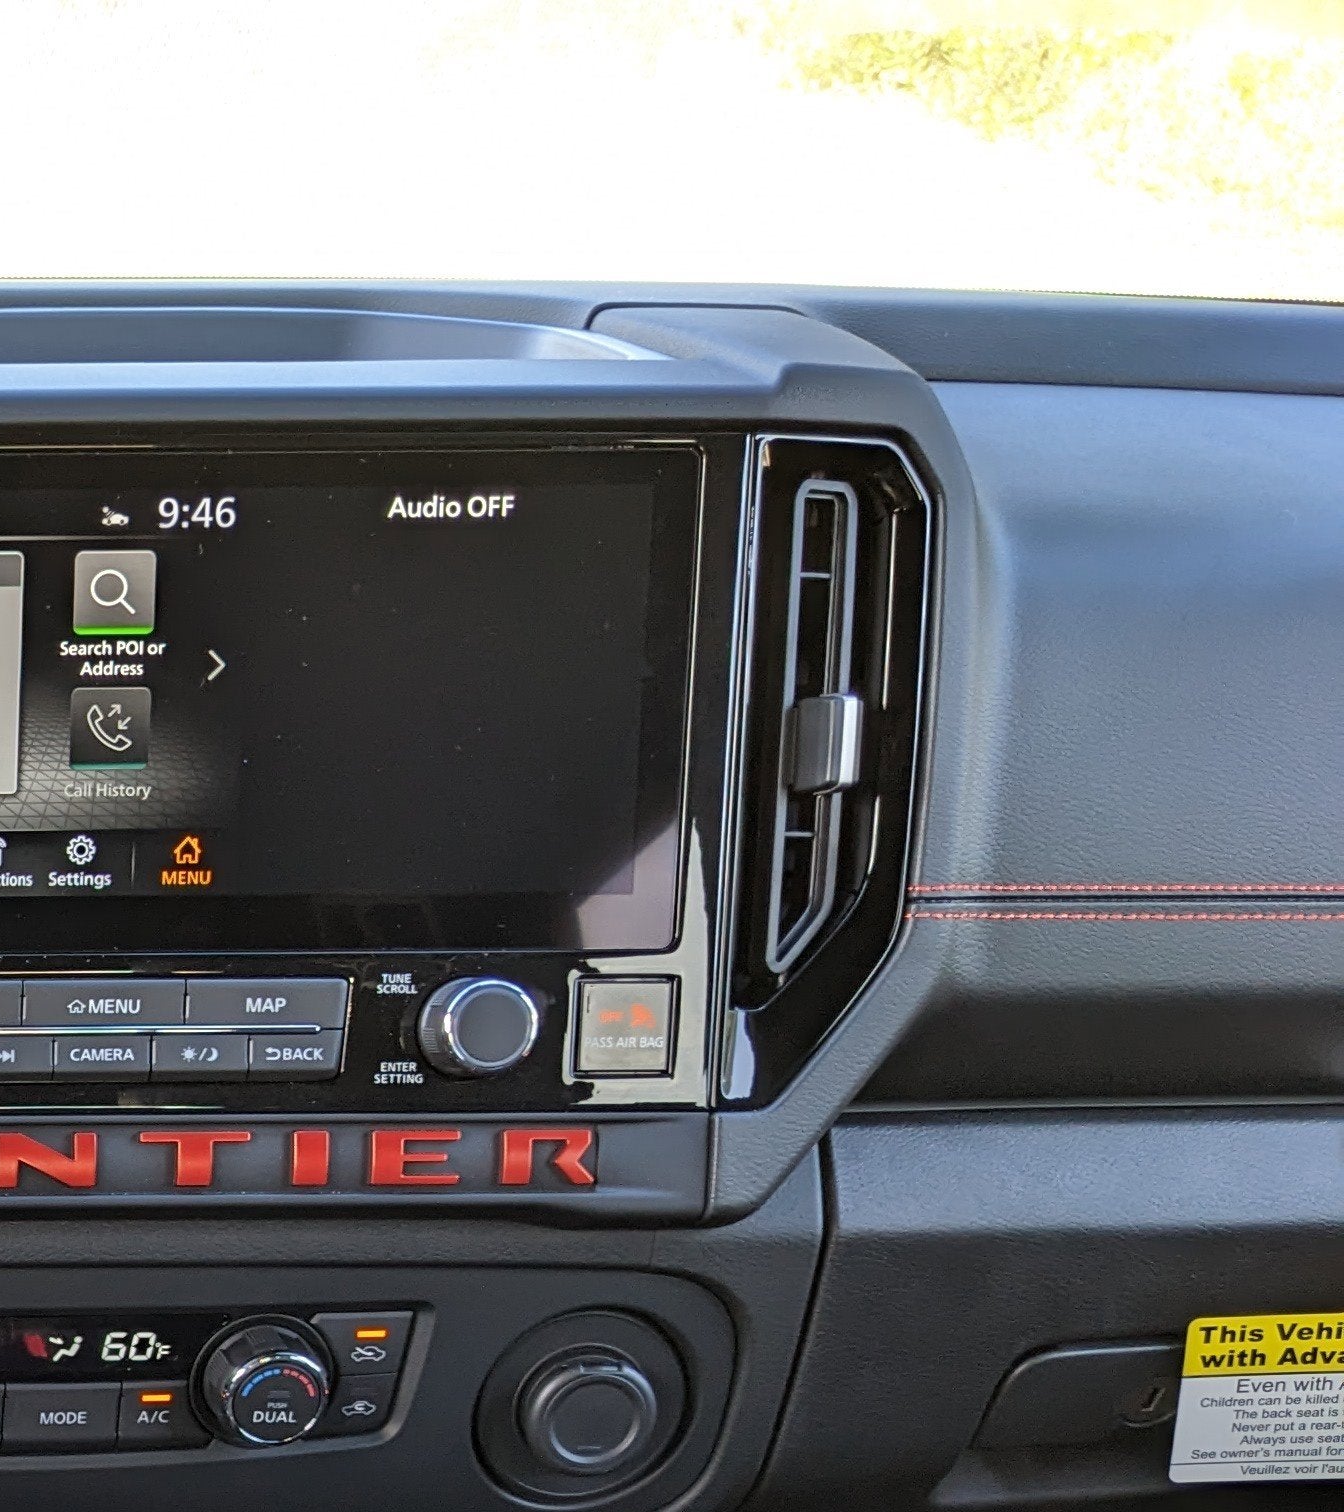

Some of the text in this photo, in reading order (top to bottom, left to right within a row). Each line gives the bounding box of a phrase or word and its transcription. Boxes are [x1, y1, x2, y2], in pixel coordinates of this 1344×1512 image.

[158, 496, 236, 530] 9:46
[388, 495, 515, 519] Audio OFF
[60, 640, 165, 656] Search POI or
[80, 660, 144, 677] Address
[64, 783, 151, 801] Call History
[48, 873, 111, 891] Settings
[161, 870, 211, 886] MENU
[381, 973, 412, 983] TUNE
[377, 984, 418, 994] SCROLL
[89, 999, 141, 1014] MENU
[246, 997, 287, 1013] MAP
[585, 1037, 664, 1048] PASS AIR BAG
[70, 1047, 135, 1062] CAMERA
[283, 1046, 323, 1061] BACK
[380, 1062, 417, 1072] ENTER
[374, 1073, 424, 1084] SETTING
[1199, 1325, 1264, 1344] This
[1200, 1349, 1266, 1369] with
[1237, 1378, 1286, 1394] Even
[1294, 1377, 1333, 1392] with
[1200, 1396, 1253, 1408] Children
[1258, 1397, 1281, 1406] can
[1285, 1395, 1301, 1405] be
[1305, 1394, 1339, 1404] killed
[39, 1411, 87, 1425] MODE
[137, 1410, 170, 1424] A/C
[253, 1410, 297, 1424] DUAL
[1234, 1410, 1257, 1420] The
[1262, 1408, 1292, 1418] back
[1296, 1408, 1324, 1418] seat
[1328, 1407, 1339, 1417] is
[1231, 1422, 1269, 1432] Never
[1274, 1421, 1294, 1433] put
[1298, 1422, 1306, 1431] a
[1239, 1435, 1286, 1446] Always
[1290, 1435, 1314, 1444] use
[1191, 1449, 1217, 1459] See
[1220, 1447, 1270, 1459] owner's
[1274, 1446, 1322, 1457] manual
[1240, 1465, 1289, 1475] Veuillez
[1294, 1463, 1319, 1474] voir
